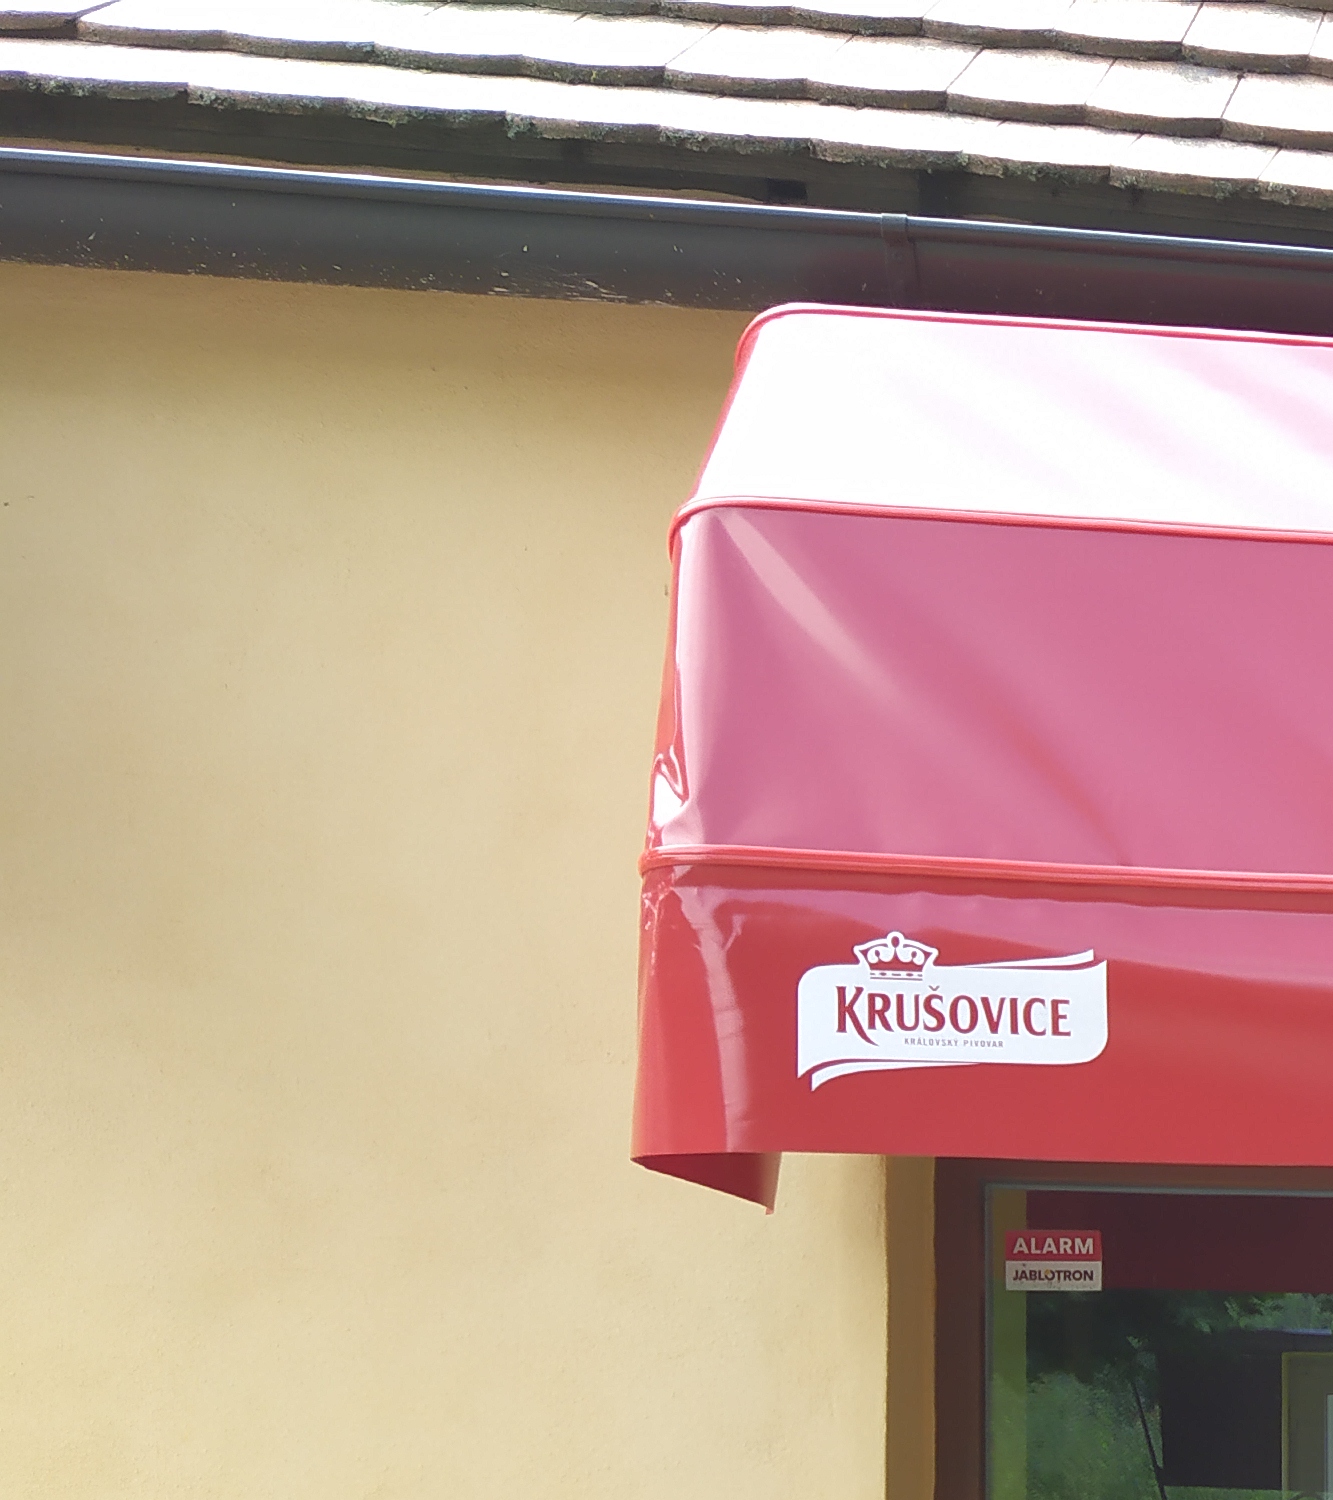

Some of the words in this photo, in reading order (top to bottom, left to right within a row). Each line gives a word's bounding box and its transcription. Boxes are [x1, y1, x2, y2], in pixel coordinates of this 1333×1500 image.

[835, 985, 1072, 1047] KRUŠOVICE
[963, 1039, 1004, 1048] PIVOVAR
[1012, 1237, 1094, 1255] ALARM
[1012, 1269, 1094, 1281] JABLOTRON
